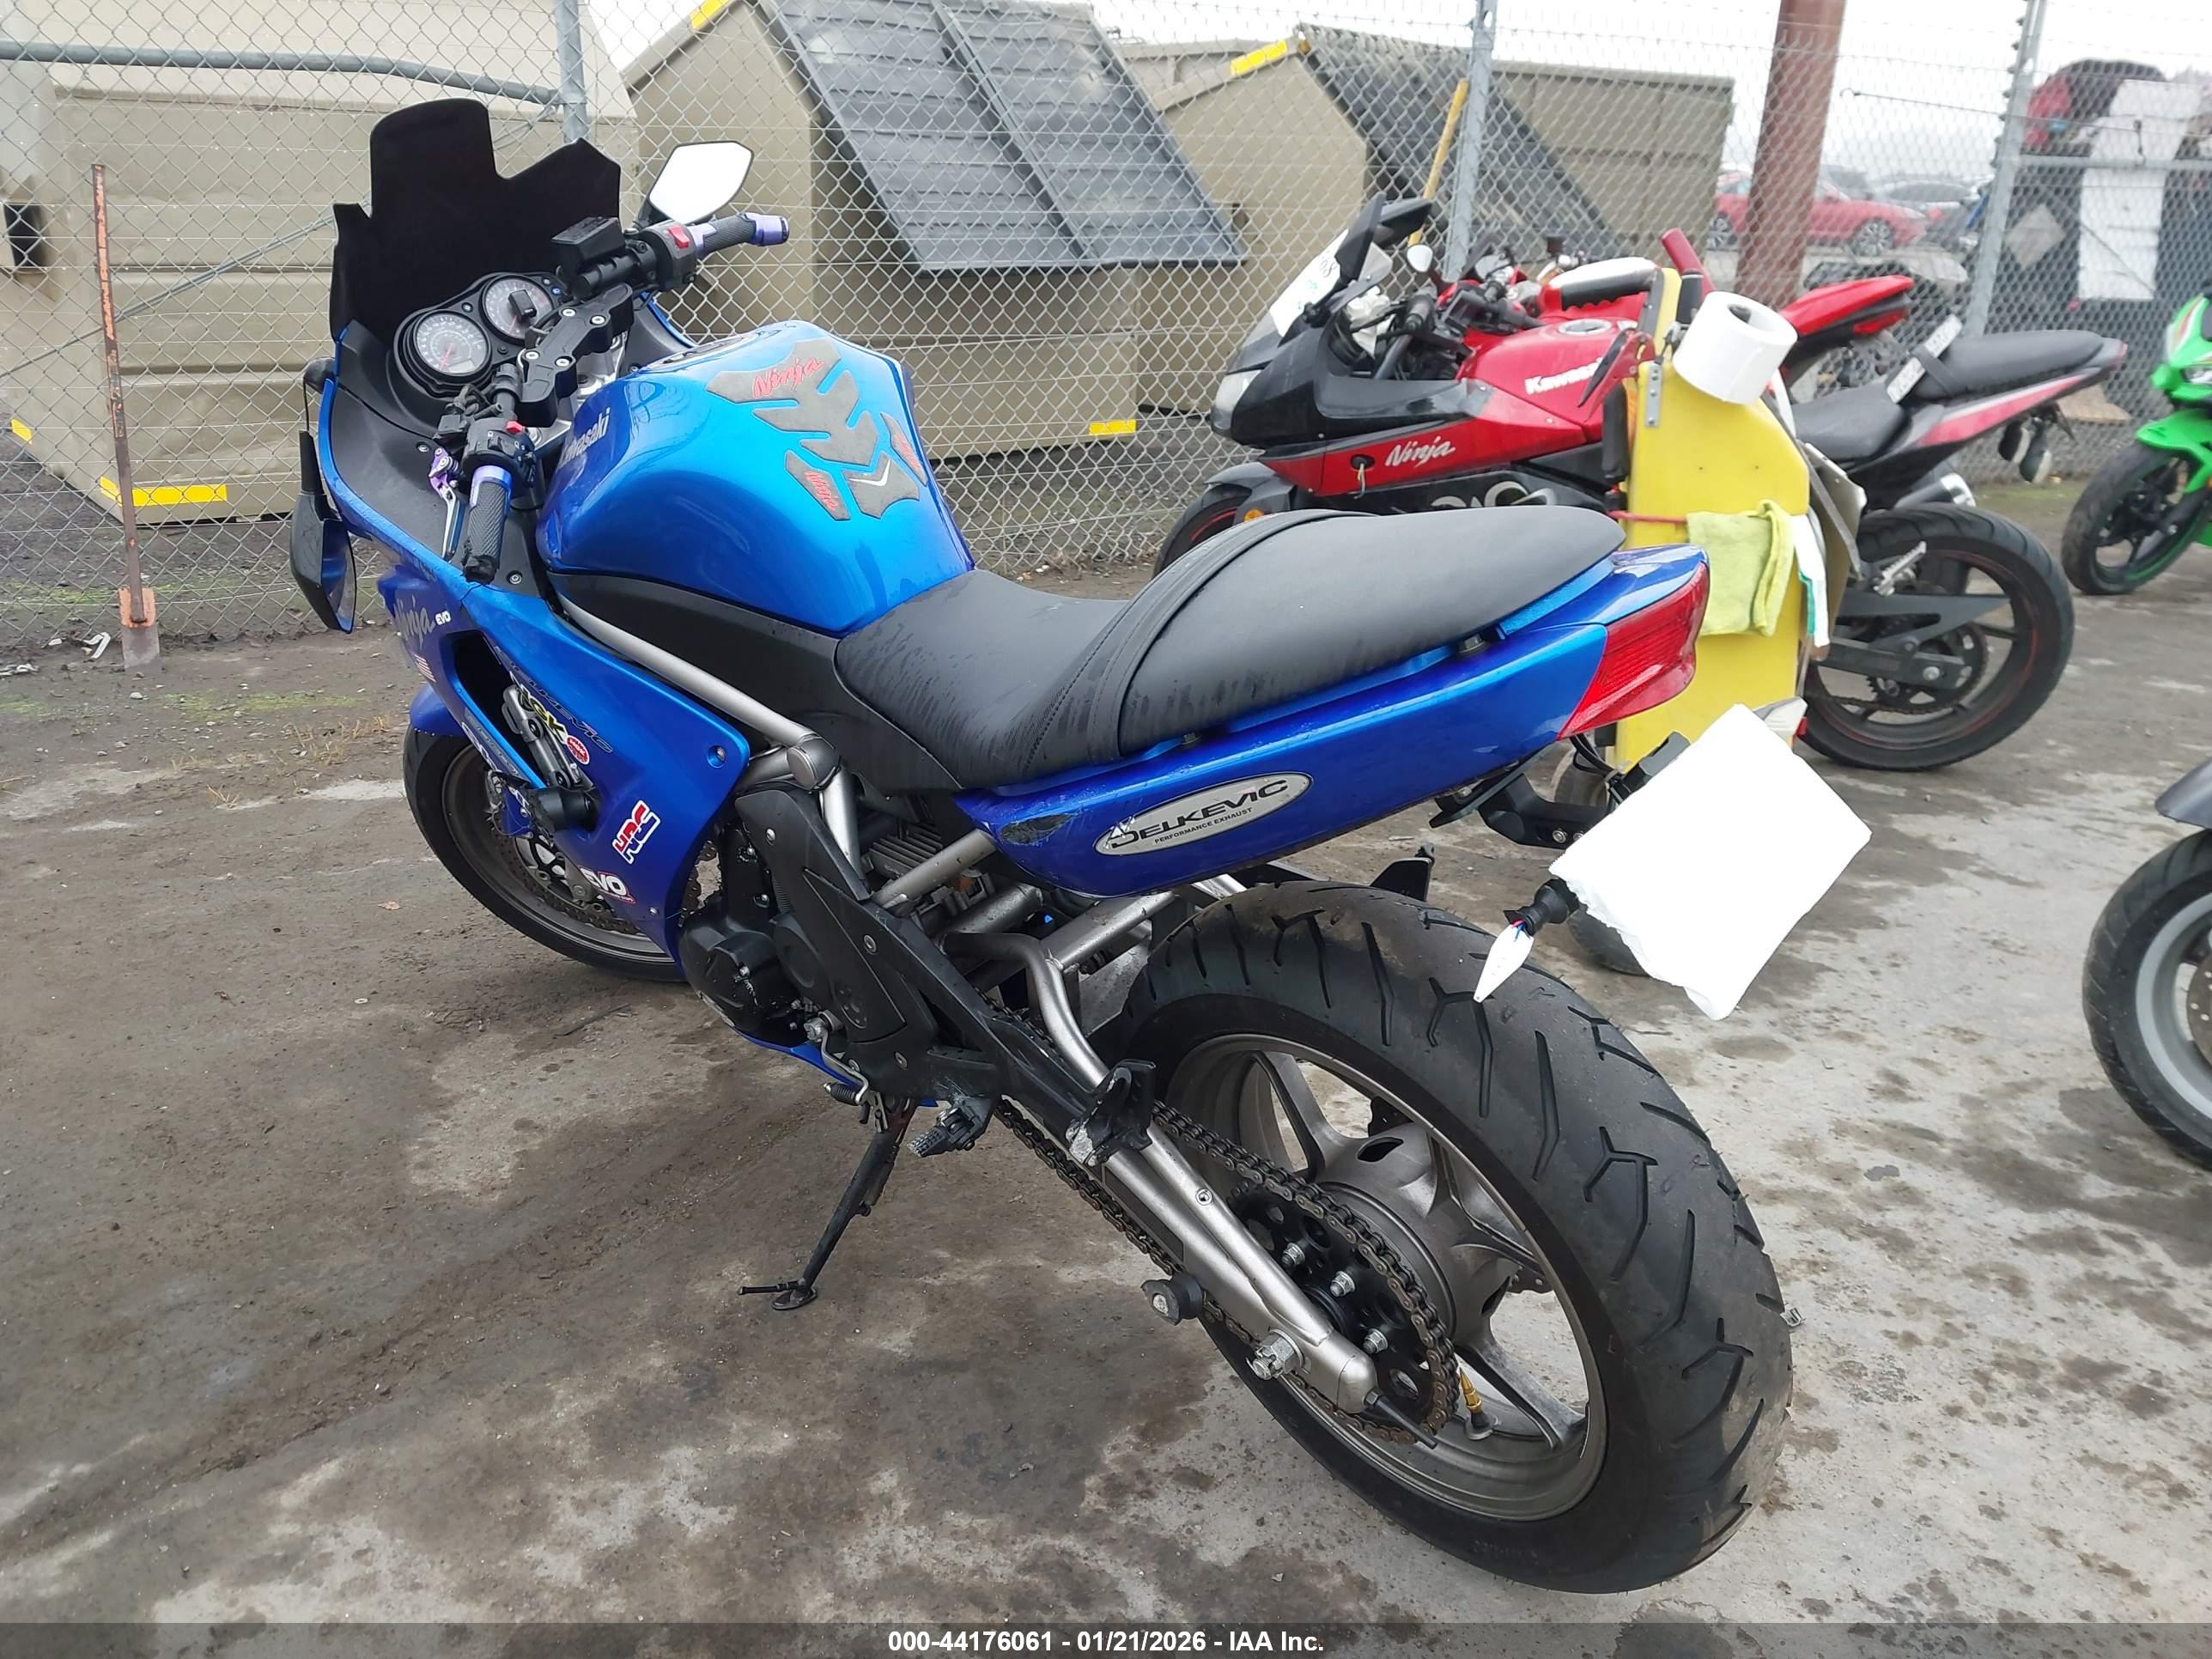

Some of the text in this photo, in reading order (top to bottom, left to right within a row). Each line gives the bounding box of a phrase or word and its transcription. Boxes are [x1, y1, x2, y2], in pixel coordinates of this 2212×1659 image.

[752, 357, 823, 398] Ninja
[1384, 435, 1456, 468] Ninja
[434, 611, 451, 625] EVO
[611, 799, 661, 865] HRC
[1111, 779, 1288, 849] DELKEVIC
[1154, 806, 1254, 844] PERFORMANCE EXHAUST
[580, 867, 628, 896] EVO
